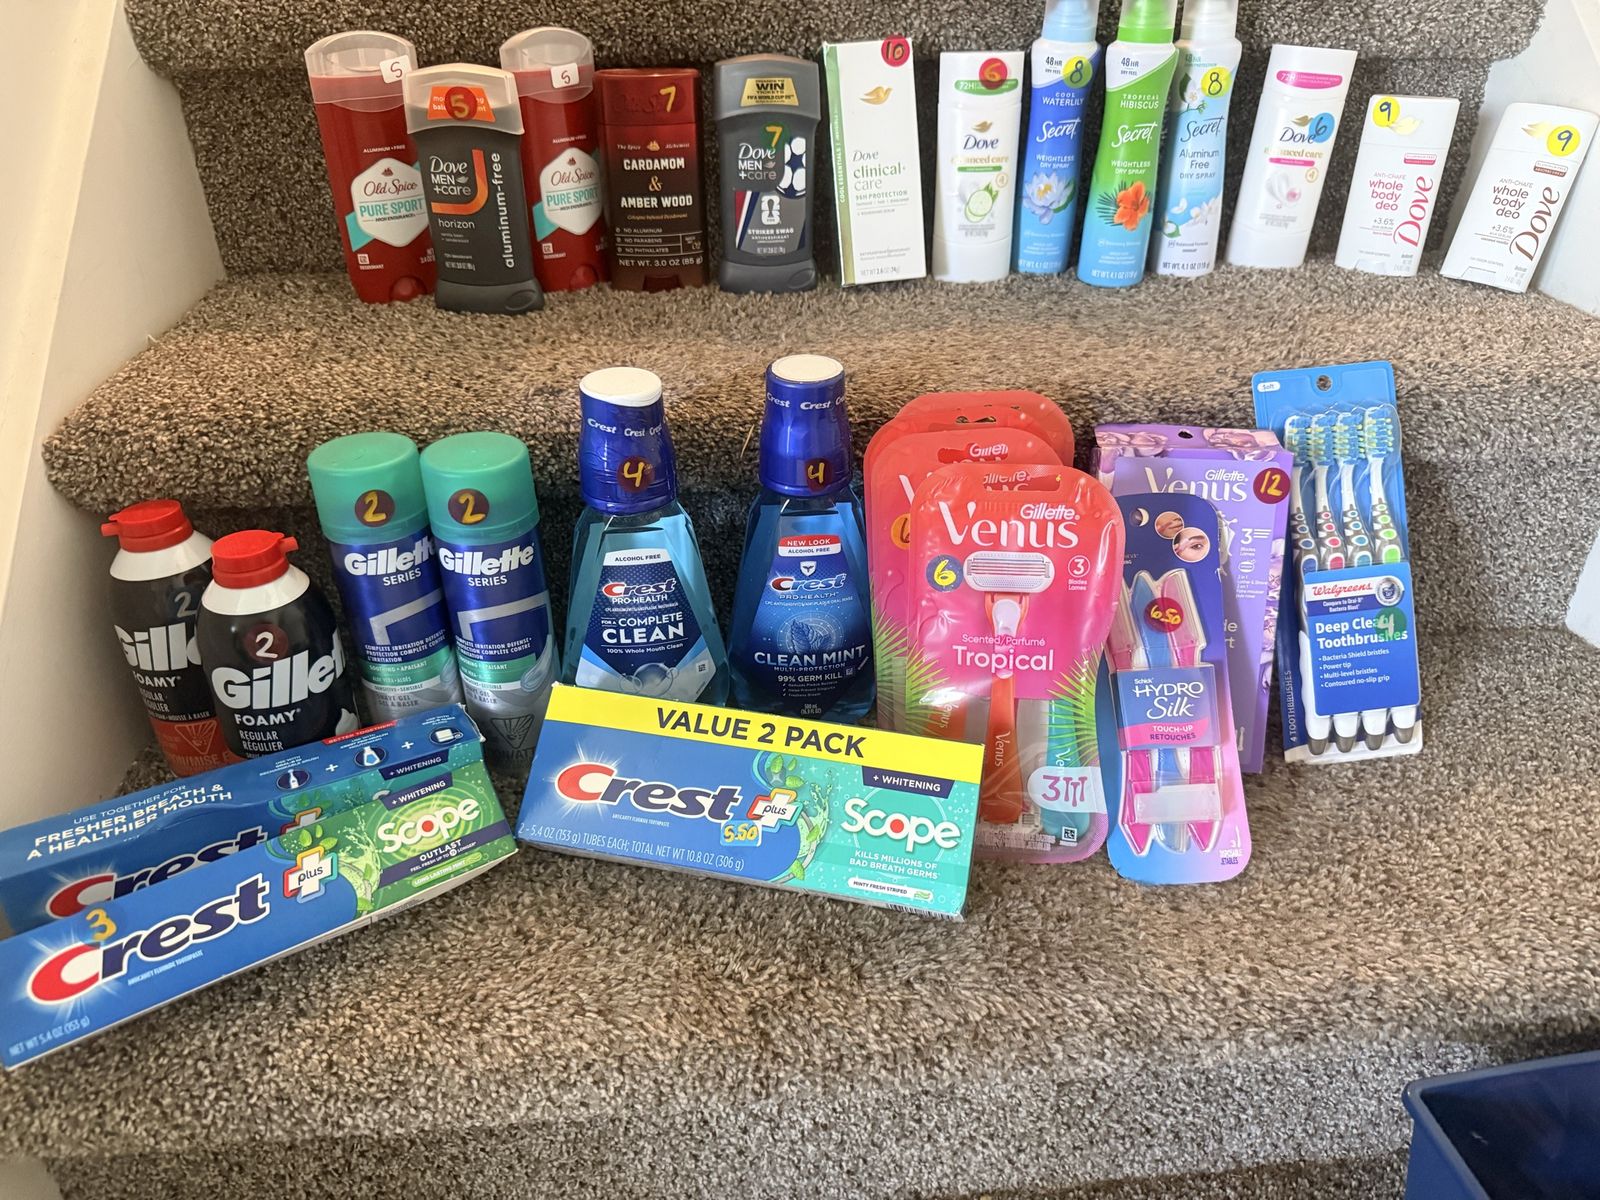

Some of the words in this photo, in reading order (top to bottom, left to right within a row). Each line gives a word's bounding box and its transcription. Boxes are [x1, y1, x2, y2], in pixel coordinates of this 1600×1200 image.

[887, 42, 905, 60] 10
[984, 63, 1001, 82] 6
[1070, 60, 1084, 84] 8
[1207, 71, 1222, 95] 8
[451, 95, 469, 118] 5
[659, 85, 676, 113] 7
[1042, 96, 1084, 107] WATERLILY
[1120, 100, 1159, 109] HIBISCUS
[1379, 101, 1392, 122] 9
[766, 126, 783, 147] 7
[1036, 117, 1081, 143] Secret
[1112, 122, 1158, 148] Secret
[1180, 116, 1225, 143] Secret
[1314, 117, 1328, 137] 6
[963, 134, 999, 150] Dove
[1557, 129, 1574, 151] 9
[738, 142, 776, 160] Dove
[853, 150, 879, 162] Dove
[1179, 149, 1220, 159] Aluminum
[429, 155, 468, 174] Dove
[623, 157, 685, 171] CARDAMOM
[738, 160, 763, 171] MEN
[853, 161, 901, 179] clinical
[1190, 160, 1210, 169] Free
[431, 173, 456, 185] MEN
[551, 171, 572, 186] Old
[571, 168, 596, 185] Spice
[648, 175, 662, 192] &
[738, 170, 777, 181] +care
[854, 177, 882, 191] care
[364, 181, 387, 196] Old
[388, 179, 417, 196] Spice
[434, 185, 471, 196] +care
[1369, 180, 1404, 191] whole
[1492, 184, 1529, 199] whole
[546, 193, 572, 207] PURE
[572, 187, 599, 204] SPORT
[621, 196, 658, 208] AMBER
[661, 195, 693, 208] WOOD
[1371, 190, 1402, 202] body
[1375, 200, 1399, 211] deo
[1492, 195, 1525, 210] body
[359, 203, 389, 217] PURE
[390, 199, 424, 214] SPORT
[491, 152, 515, 269] aluminum-free
[1393, 175, 1434, 248] Dove
[1495, 207, 1520, 219] deo
[438, 218, 476, 229] horizon
[1509, 186, 1561, 262] Dove
[619, 259, 635, 267] NET
[637, 259, 652, 267] WT.
[654, 259, 667, 267] 3.0
[1262, 383, 1275, 391] Soft
[767, 392, 791, 408] Crest
[800, 401, 832, 410] Crest
[623, 461, 645, 488] 4
[807, 462, 825, 484] 4
[1205, 469, 1245, 482] Gillette
[1144, 467, 1248, 502] Venus
[1259, 471, 1282, 497] 12
[364, 491, 387, 522] 2
[458, 492, 487, 524] 2
[1020, 503, 1076, 521] Gillette
[938, 501, 1079, 549] Venus
[1240, 528, 1253, 545] 3
[439, 545, 534, 577] Gillette
[1073, 558, 1085, 575] 3
[383, 568, 422, 587] SERIES
[467, 574, 508, 587] SERIES
[933, 558, 957, 586] 6
[602, 578, 677, 597] Crest
[771, 573, 847, 592] Crest
[1312, 583, 1373, 597] Walgreens
[174, 591, 197, 619] 2
[612, 594, 668, 604] PRO-HEALTH
[618, 612, 683, 627] COMPLETE
[1315, 620, 1350, 637] Deep
[602, 622, 684, 644] CLEAN
[962, 633, 1046, 647] Scented/Parfumé
[1316, 629, 1408, 650] Toothbrushes
[255, 631, 278, 660] 2
[624, 646, 645, 654] Whole
[646, 645, 665, 653] Mouth
[754, 651, 816, 667] CLEAN
[823, 644, 866, 665] MINT
[952, 645, 1054, 674] Tropical
[774, 663, 846, 672] MULTI-PROTECTION
[797, 674, 823, 682] GERM
[824, 672, 843, 680] KILL
[1132, 682, 1203, 699] HYDRO
[1146, 697, 1194, 720] Silk
[1285, 670, 1297, 736] TOOTHBRUSHES
[235, 711, 296, 727] FOAMY
[1151, 724, 1194, 733] TOUCH-UP
[240, 730, 279, 741] REGULAR
[656, 707, 751, 741] VALUE
[758, 722, 776, 744] 2
[785, 725, 867, 759] PACK
[1150, 733, 1197, 741] RETOUCHES
[995, 730, 1011, 768] Venus
[396, 757, 442, 775] WHITENING
[398, 780, 446, 804] WHITENING
[555, 762, 742, 823] Crest
[882, 775, 941, 793] WHITENING
[74, 814, 97, 824] USE
[101, 795, 161, 818] TOGETHER
[163, 785, 186, 797] FOR
[762, 804, 788, 816] plus
[35, 815, 127, 847] FRESHER
[133, 786, 205, 819] BREATH
[211, 783, 224, 793] &
[26, 849, 42, 862] A
[48, 812, 159, 854] HEALTHIER
[163, 791, 233, 814] MOUTH
[377, 798, 481, 854] Scope
[841, 797, 961, 853] Scope
[420, 839, 461, 862] OUTLAST
[518, 822, 525, 834] 2
[531, 825, 543, 837] 5.4
[543, 827, 554, 839] OZ
[555, 828, 571, 843] (153
[571, 832, 581, 845] g)
[582, 833, 606, 847] TUBES
[607, 837, 629, 851] EACH;
[631, 840, 654, 856] TOTAL
[656, 845, 671, 858] NET
[672, 847, 685, 860] WT
[686, 849, 702, 863] 10.8
[703, 853, 714, 866] OZ
[715, 854, 734, 869] (306
[735, 858, 745, 871] g)
[849, 857, 868, 869] BAD
[869, 861, 905, 875] BREATH
[906, 868, 938, 880] GERMS
[855, 850, 879, 861] KILLS
[881, 854, 923, 868] MILLIONS
[924, 862, 938, 870] OF
[46, 825, 269, 919] Crest
[297, 865, 324, 885] plus
[869, 883, 886, 891] FRESH
[886, 886, 908, 895] STRIPED
[86, 908, 118, 943] 3
[27, 873, 271, 1005] Crest
